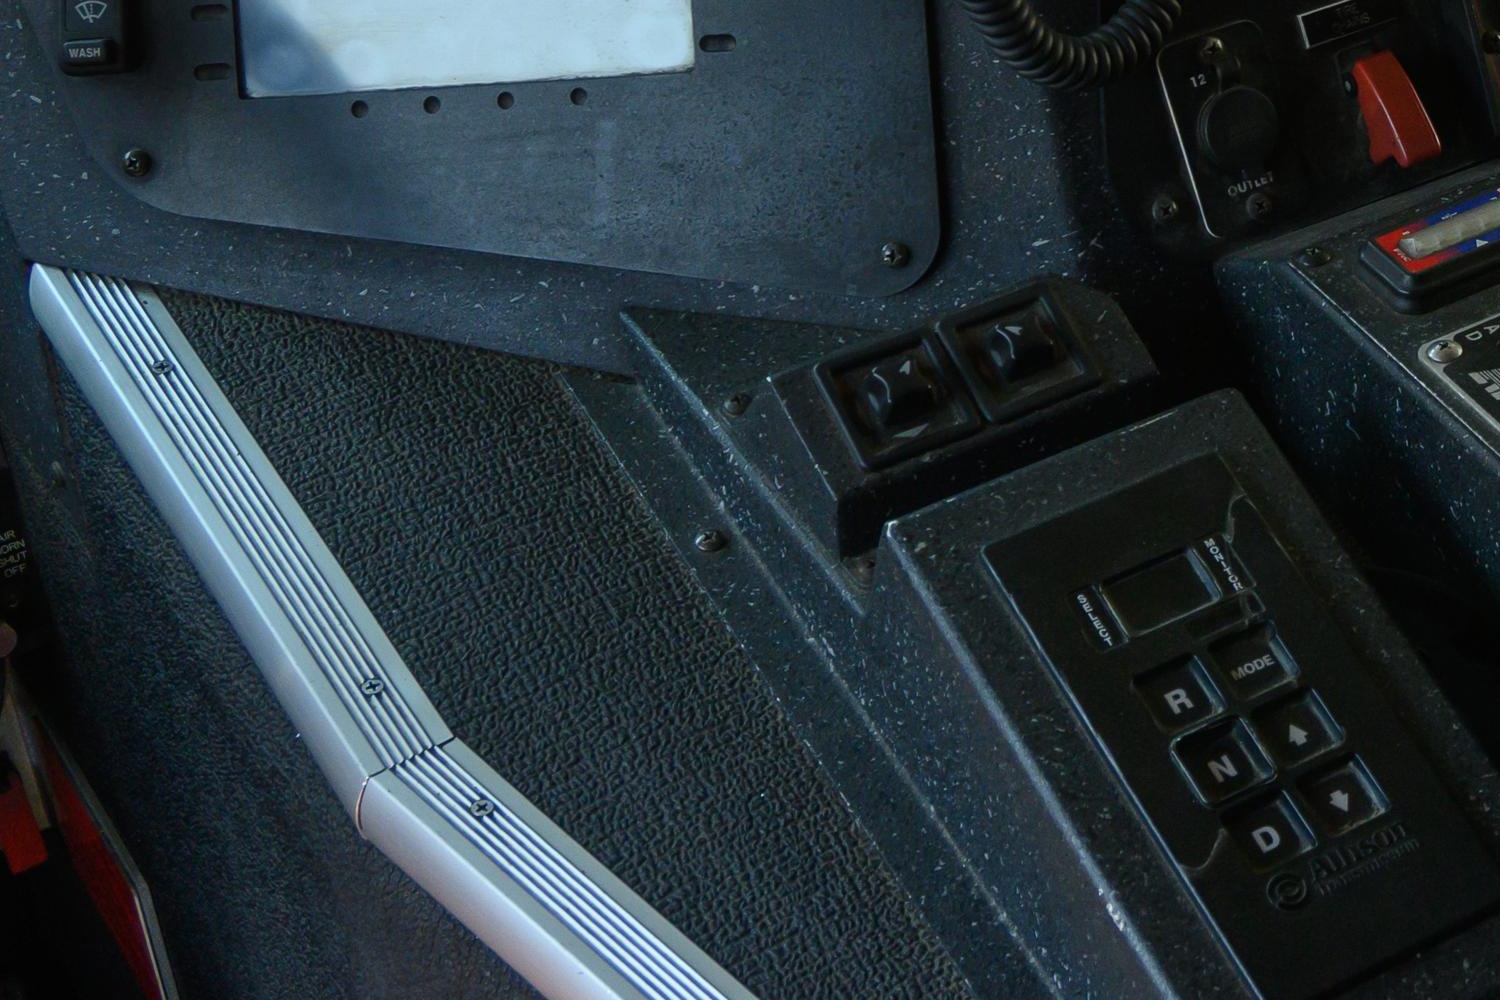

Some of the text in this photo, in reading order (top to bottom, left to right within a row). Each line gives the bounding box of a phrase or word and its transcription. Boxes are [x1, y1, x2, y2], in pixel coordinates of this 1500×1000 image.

[69, 48, 100, 58] WASH
[1190, 74, 1207, 87] 12
[1227, 170, 1274, 197] OUTLET
[0, 539, 26, 554] ORN
[4, 563, 26, 577] OFF
[1203, 537, 1244, 591] MONITOR
[1076, 593, 1113, 647] SELECT
[1231, 654, 1277, 681] MODE
[1163, 688, 1194, 715] R
[1207, 754, 1238, 784] N
[1251, 825, 1281, 854] D
